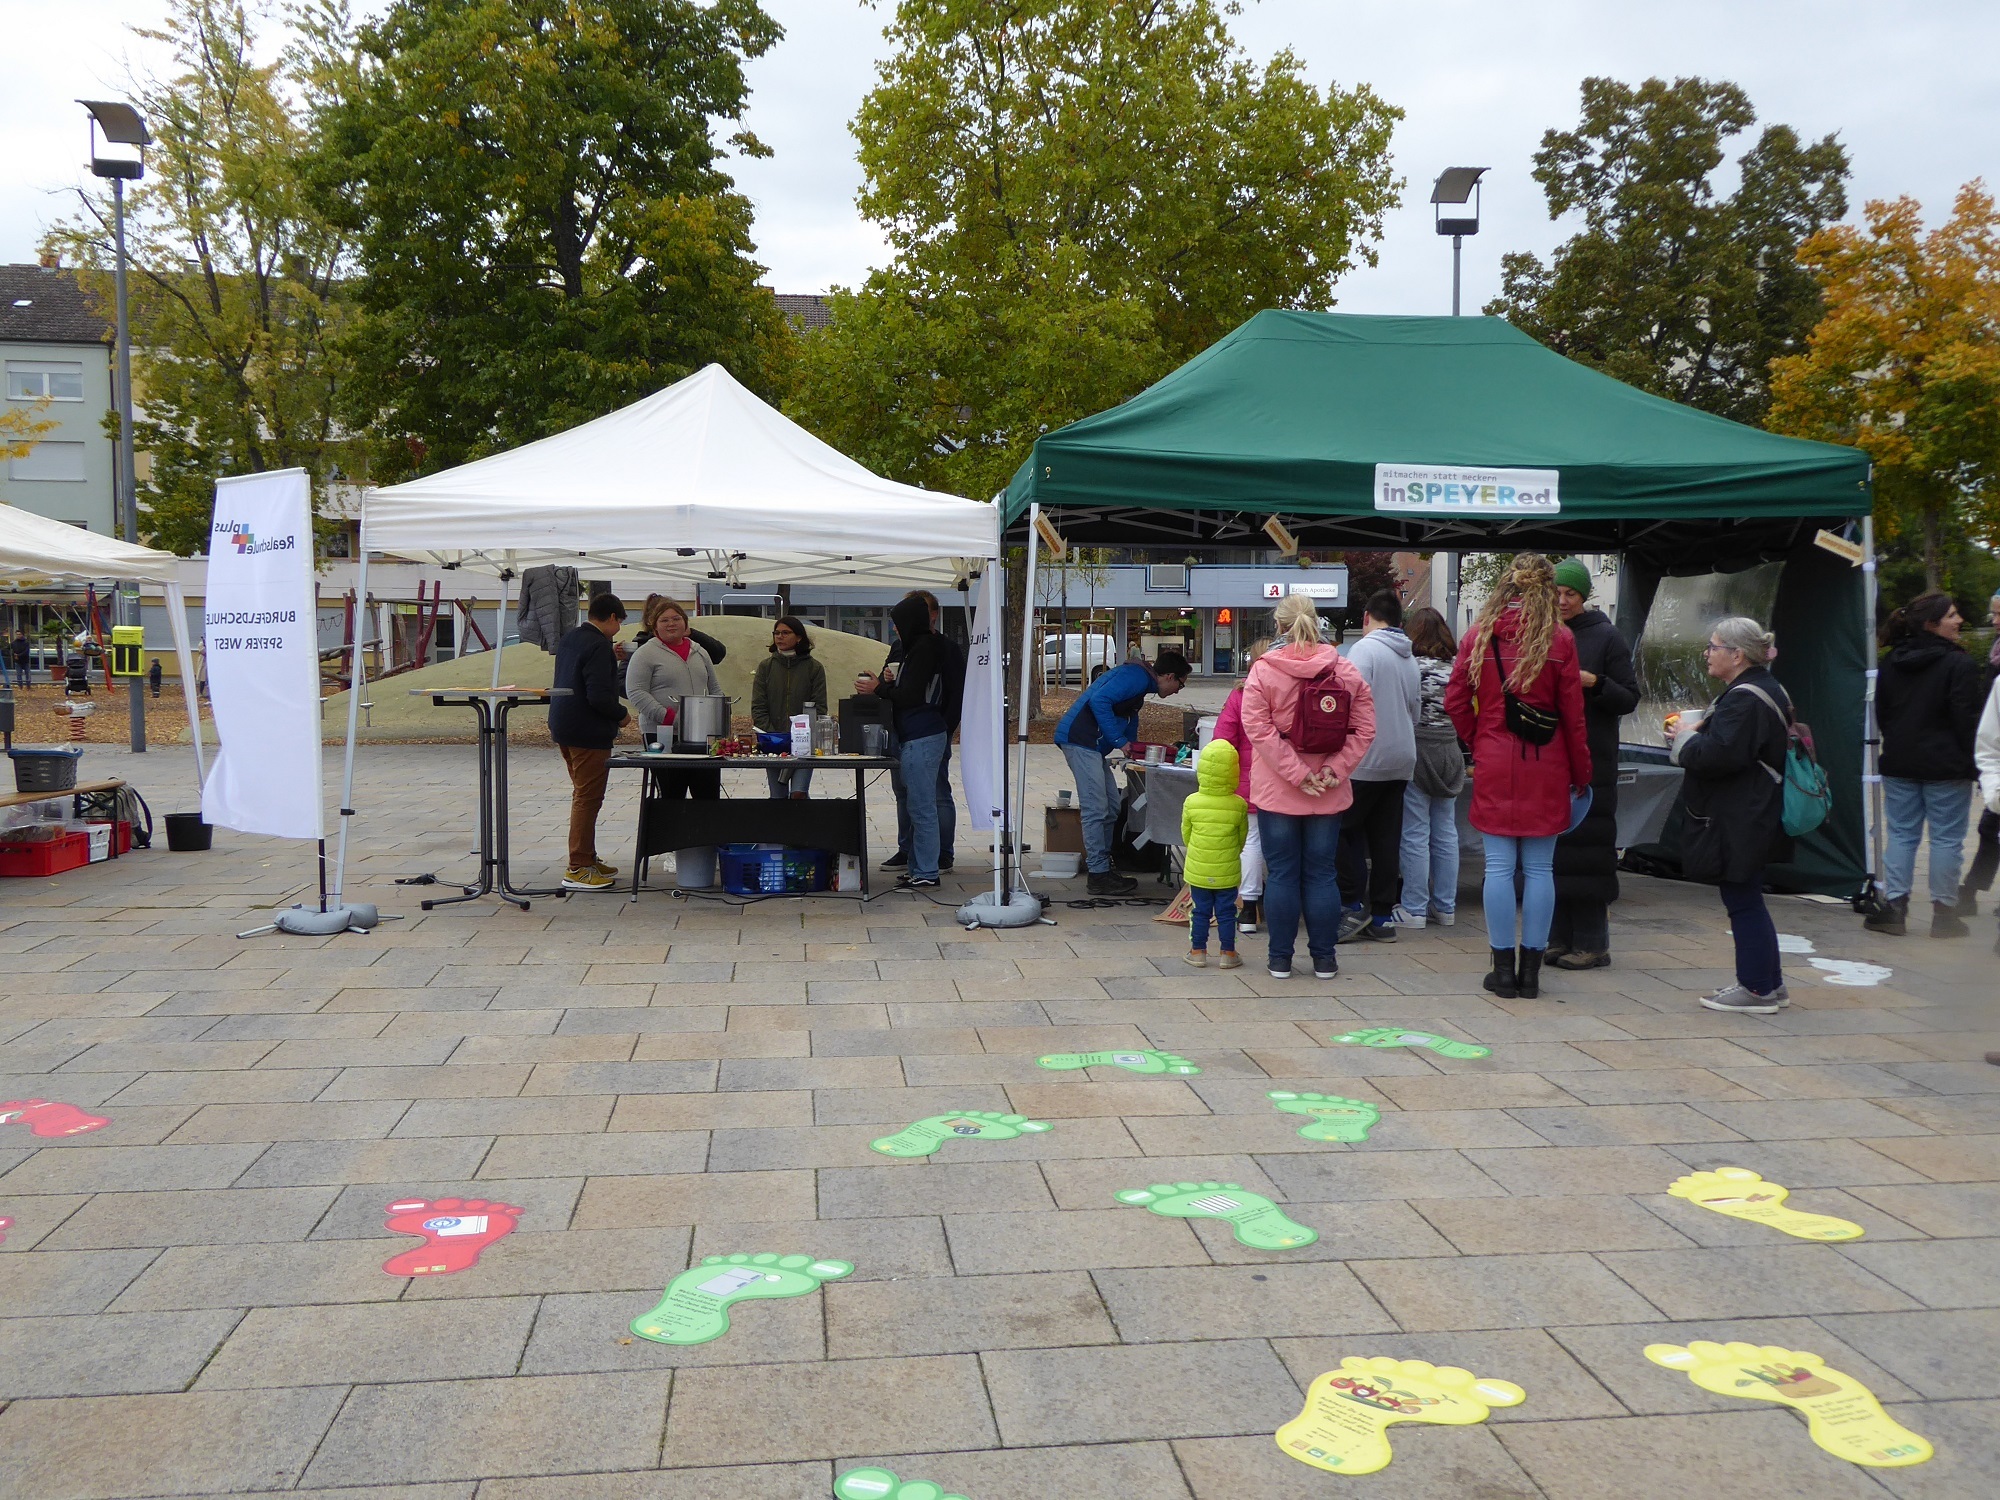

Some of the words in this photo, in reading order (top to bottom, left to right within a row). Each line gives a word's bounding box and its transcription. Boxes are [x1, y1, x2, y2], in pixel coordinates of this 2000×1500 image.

[1382, 470, 1428, 479] mitmachen
[1433, 472, 1457, 480] statt
[1462, 474, 1497, 482] meckern
[1382, 482, 1552, 506] inSPEYERed
